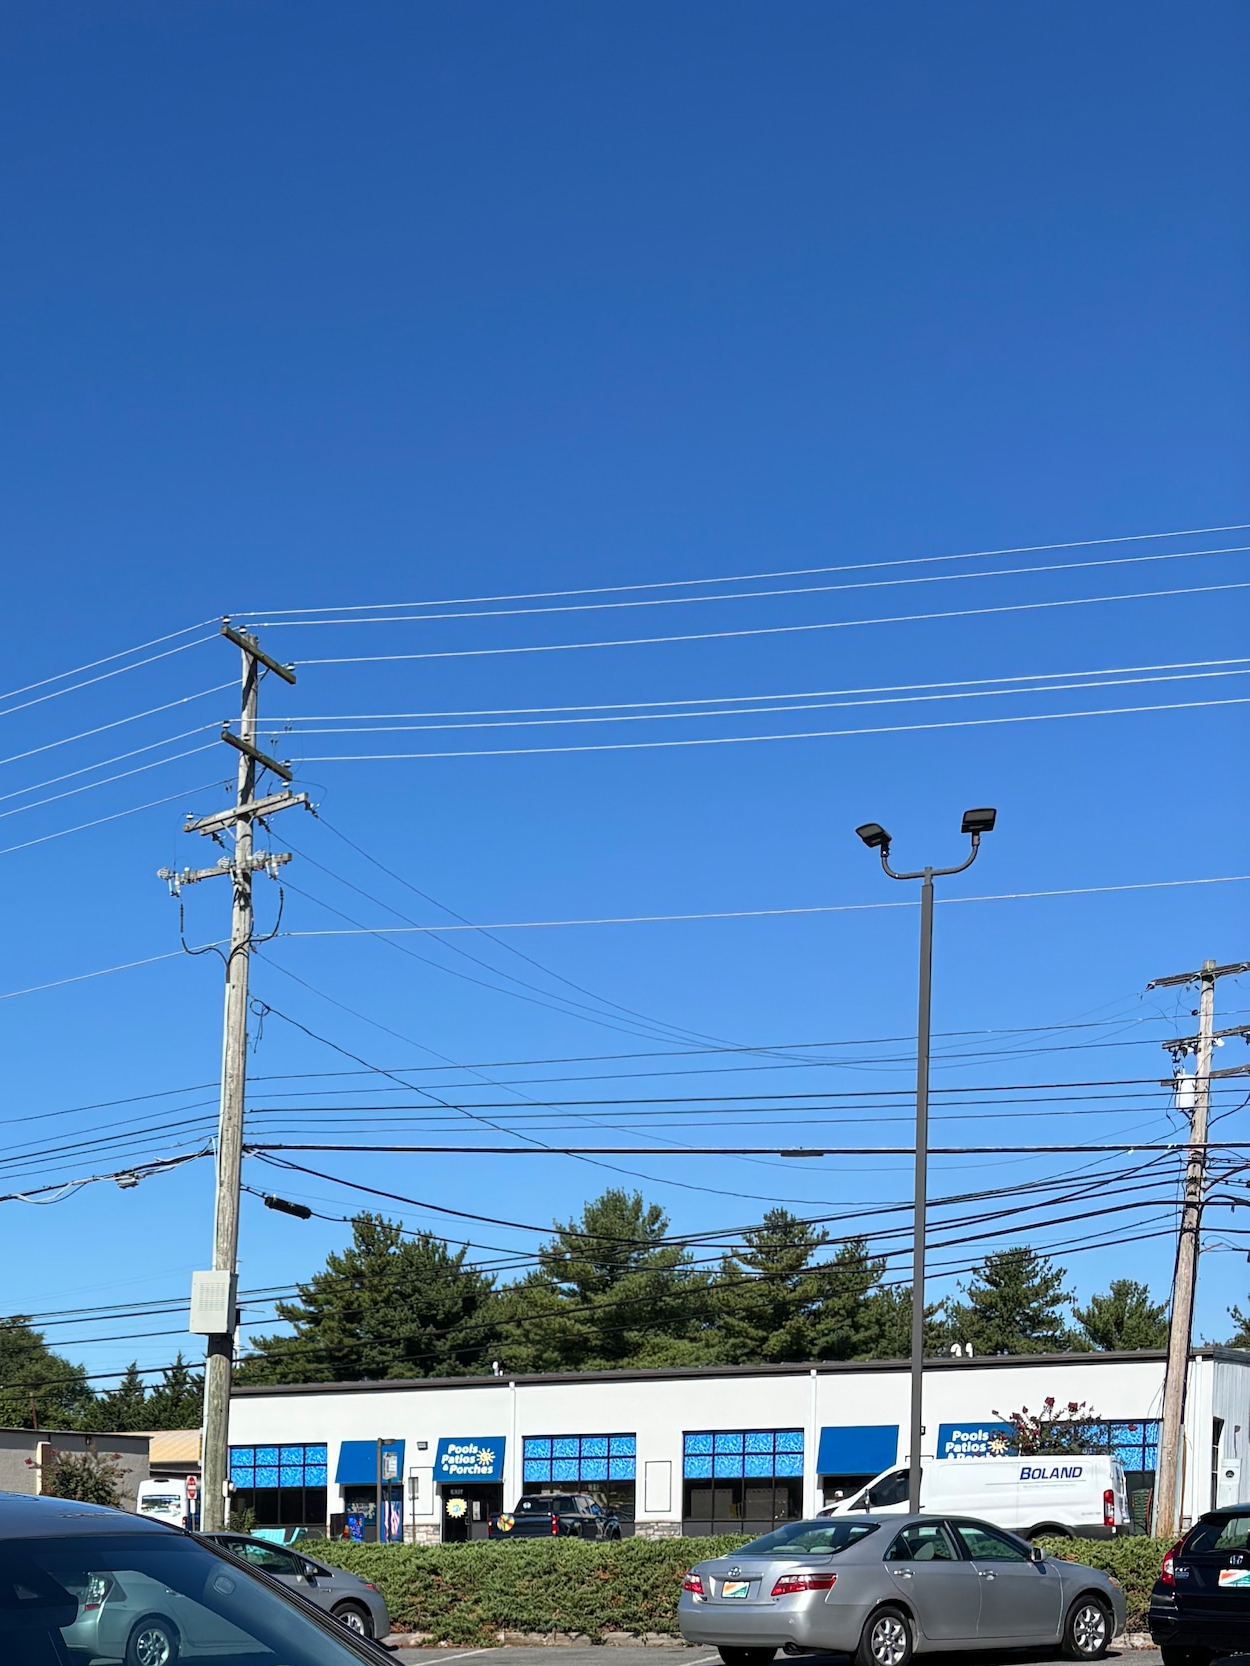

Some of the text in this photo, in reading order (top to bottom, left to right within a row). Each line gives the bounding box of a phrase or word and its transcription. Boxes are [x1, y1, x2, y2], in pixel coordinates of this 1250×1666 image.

[952, 1429, 989, 1441] Pools
[448, 1443, 478, 1454] Pools
[945, 1441, 986, 1453] Patios
[441, 1454, 476, 1465] Patios
[449, 1464, 493, 1474] Porches
[1020, 1467, 1083, 1480] BOLAND
